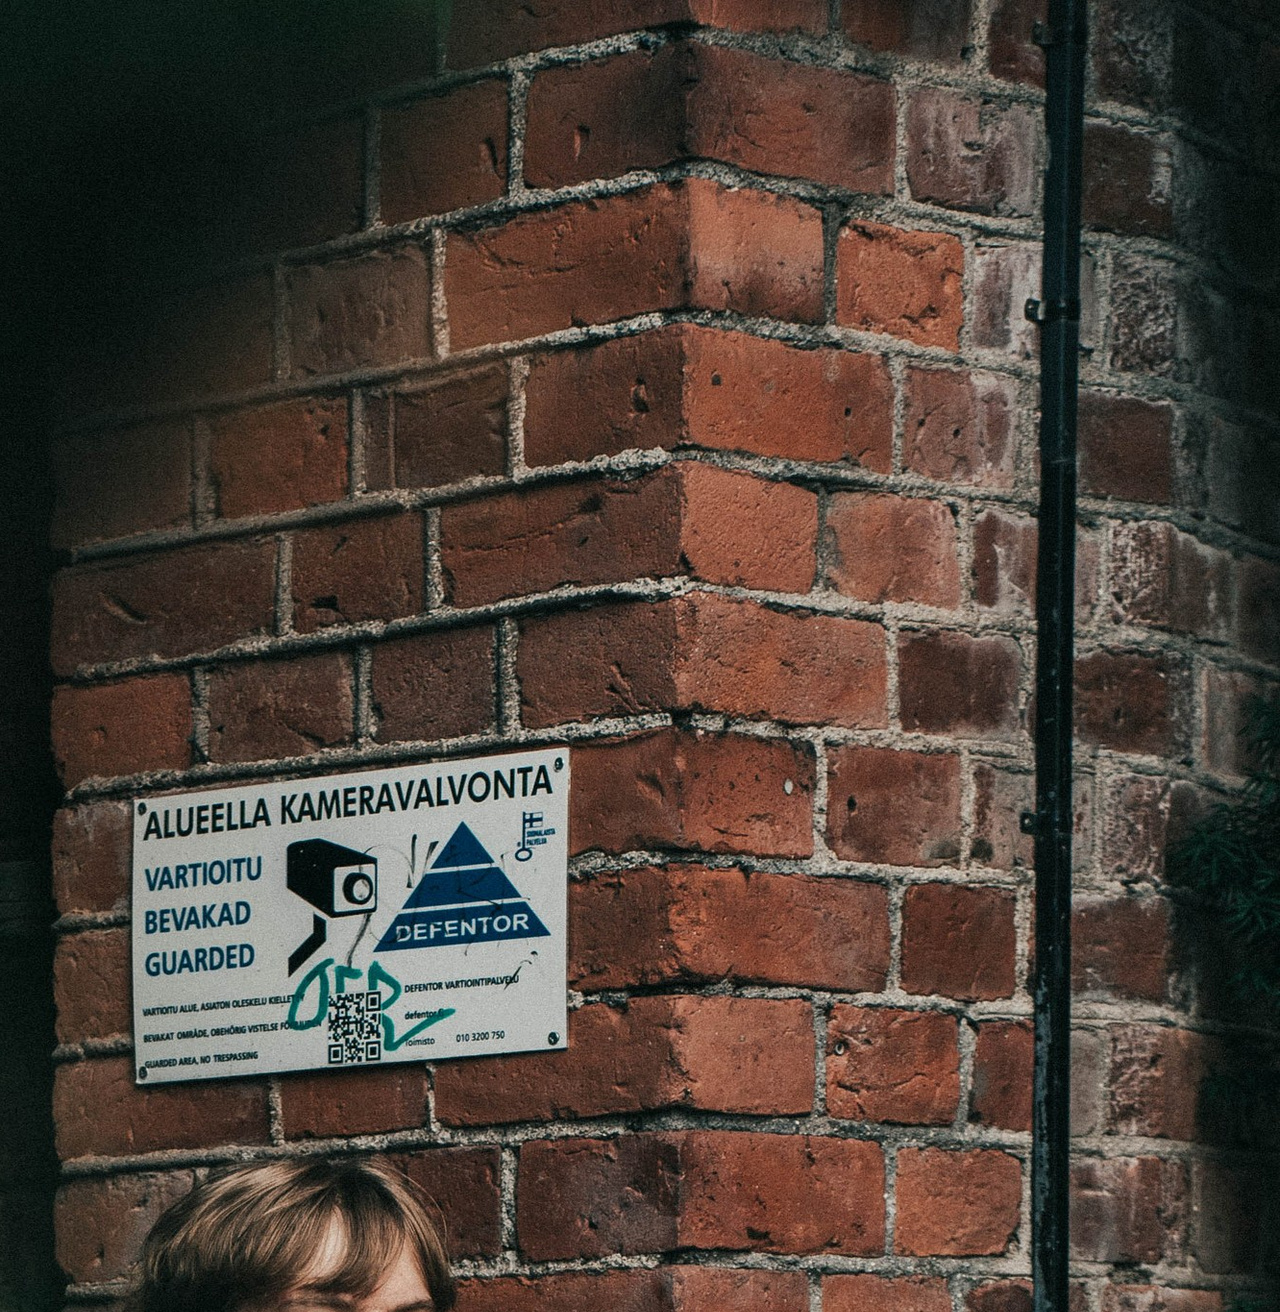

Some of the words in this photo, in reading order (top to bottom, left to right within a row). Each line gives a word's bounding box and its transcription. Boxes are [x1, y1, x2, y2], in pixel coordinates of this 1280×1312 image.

[143, 797, 271, 841] ALUEELLA
[280, 765, 553, 825] KAMERAVALVONTA
[144, 856, 263, 892] VARTIOITU
[144, 901, 251, 934] BEVAKAD
[395, 913, 529, 943] DEFENTOR
[145, 943, 255, 977] GUARDED
[404, 981, 443, 993] DEFENTOR
[445, 975, 519, 990] VARTIOINTIPALVELU
[142, 1006, 179, 1017] VARTIOITU
[179, 1003, 199, 1013] ALUE,
[200, 1000, 230, 1011] ASIATON
[232, 997, 267, 1008] OLESKELU
[143, 1032, 175, 1043] BEVAKAT
[211, 1025, 247, 1037] OBEHÖRIG
[248, 1022, 279, 1034] VISTELSE
[456, 1033, 470, 1043] 010
[471, 1031, 490, 1042] 3200
[491, 1030, 505, 1040] 750
[145, 1058, 178, 1069] GUARDED
[179, 1056, 198, 1067] AREA,
[200, 1054, 211, 1064] NO
[214, 1051, 259, 1063] TRESPASSING
